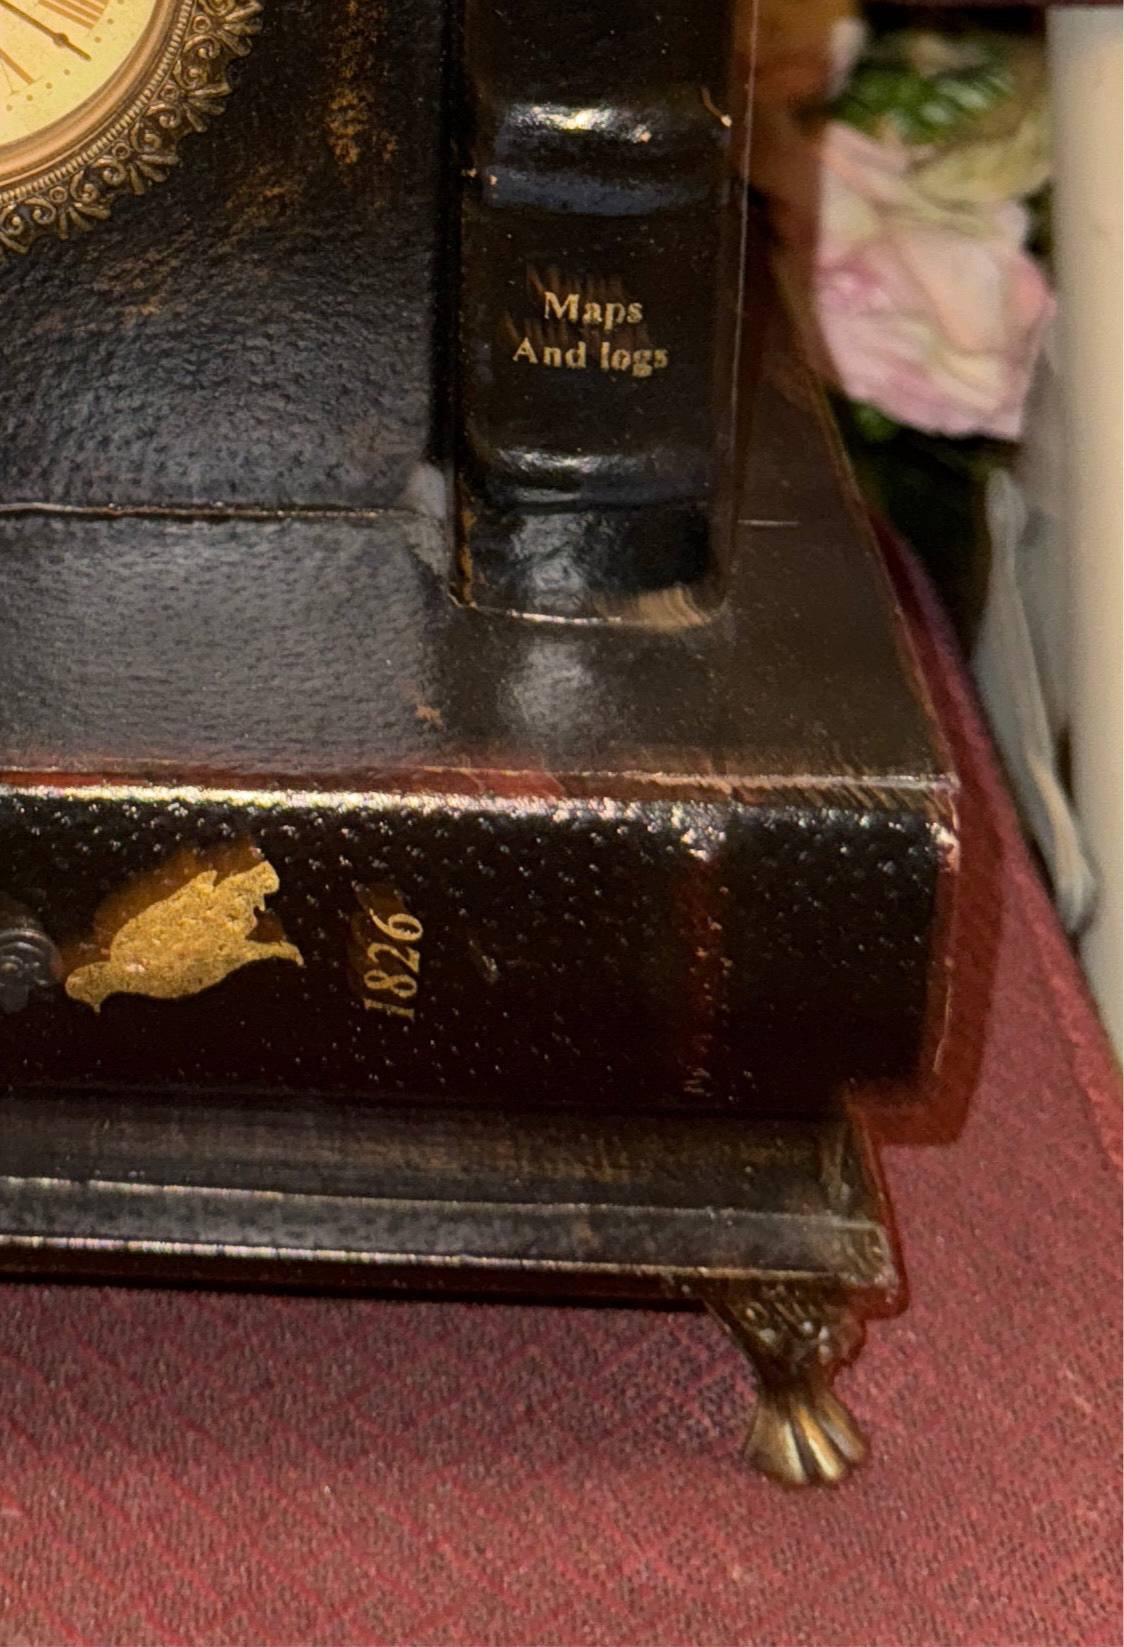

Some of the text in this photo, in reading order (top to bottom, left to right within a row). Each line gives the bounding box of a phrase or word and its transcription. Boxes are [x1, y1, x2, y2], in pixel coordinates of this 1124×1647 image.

[543, 290, 644, 333] Maps
[512, 337, 669, 379] And logs
[363, 907, 423, 1023] 1826
